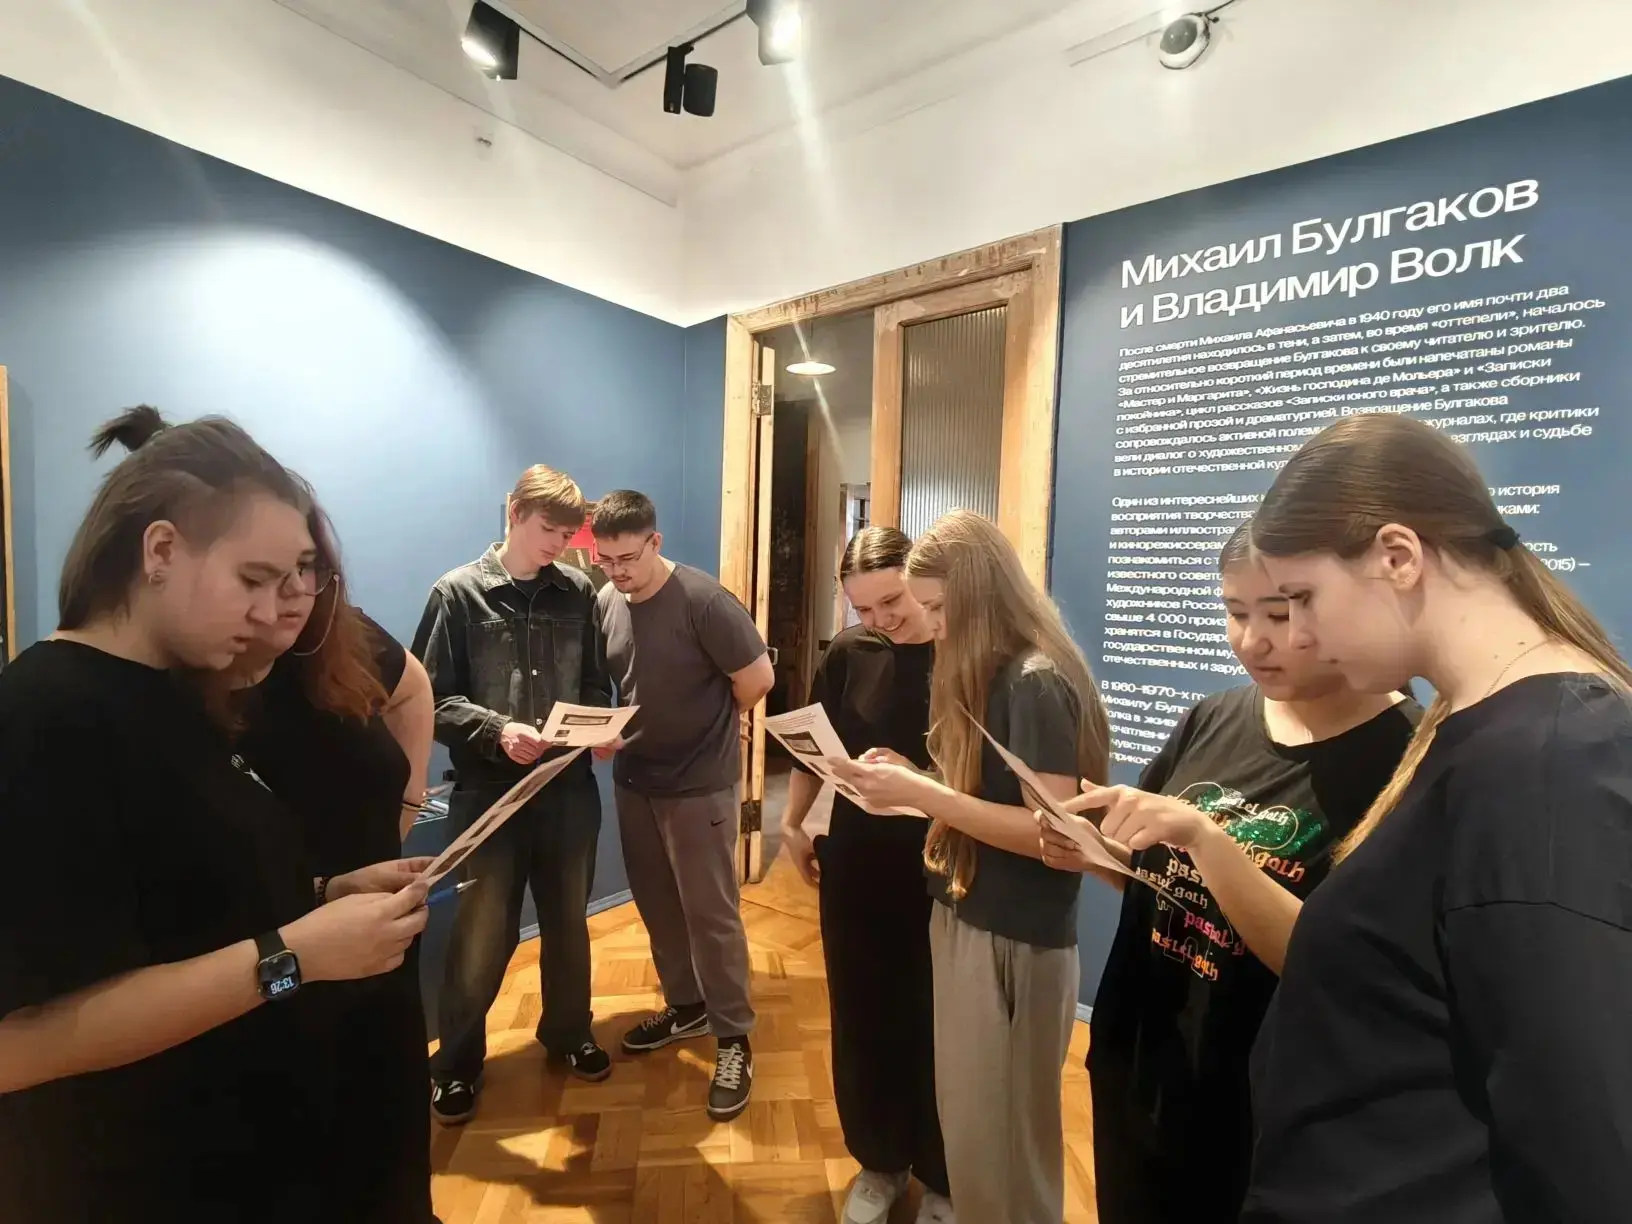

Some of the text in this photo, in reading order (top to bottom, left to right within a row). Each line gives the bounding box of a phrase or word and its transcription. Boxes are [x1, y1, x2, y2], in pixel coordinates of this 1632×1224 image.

[1121, 179, 1539, 289] Михаил Булгаков
[1120, 233, 1527, 329] и Владимир Волк
[1119, 285, 1569, 357] После смерти Михаила Афанасьевича в 1940 году его имя почти два
[1118, 298, 1605, 371] десятилетия находилось в тени, а затем, во время «оттепели», началось
[1118, 319, 1586, 384] стремительное возвращение Булгакова к своему читателю и зрителю.
[1118, 338, 1573, 397] За относительно короткий период времени были напечатаны романы
[1118, 358, 1552, 409] «Мастер и Маргарита», «Жизнь господина де Мольера» и «Записки
[1116, 409, 1184, 422] покойника»,
[1185, 406, 1216, 417] цикл
[1217, 398, 1283, 415] рассказов
[1347, 389, 1387, 401] юного
[1389, 385, 1439, 399] врача»,
[1441, 384, 1450, 393] а
[1453, 378, 1498, 392] также
[1501, 372, 1581, 387] сборники
[1115, 427, 1124, 435] с
[1125, 420, 1188, 434] избранной
[1189, 416, 1234, 430] прозой
[1236, 417, 1244, 425] и
[1245, 407, 1339, 426] драматургией.
[1434, 395, 1508, 411] Булгакова
[1115, 435, 1217, 450] сопровождалось
[1218, 427, 1276, 442] активной
[1500, 412, 1526, 424] где
[1529, 406, 1600, 421] критики
[1115, 454, 1142, 463] вели
[1142, 450, 1186, 463] диалог
[1187, 449, 1196, 459] о
[1520, 428, 1529, 439] и
[1532, 424, 1593, 440] судьбе
[1113, 468, 1121, 477] в
[1122, 465, 1171, 476] истории
[1172, 458, 1265, 475] отечественной
[1112, 497, 1143, 508] Один
[1144, 496, 1159, 505] из
[1160, 493, 1259, 507] интереснейших
[1498, 484, 1560, 497] история
[1110, 511, 1182, 522] восприятия
[1110, 526, 1169, 536] авторами
[1109, 541, 1117, 549] и
[1108, 556, 1202, 566] познакомиться
[1203, 557, 1213, 565] с
[1106, 570, 1177, 580] известного
[1106, 583, 1212, 597] Международной
[1105, 598, 1181, 609] художников
[1104, 612, 1144, 623] свыше
[1145, 612, 1156, 622] 4
[1158, 613, 1187, 624] 000
[1104, 626, 1161, 638] хранятся
[1163, 630, 1172, 638] в
[1102, 640, 1215, 657] государственном
[1102, 654, 1199, 670] отечественных
[1200, 662, 1209, 670] и
[1101, 680, 1109, 690] В
[1100, 693, 1153, 711] Михаилу
[1133, 713, 1141, 722] в
[1166, 858, 1205, 888] pas
[1254, 851, 1306, 883] goth
[1173, 886, 1208, 909] goth
[1194, 955, 1219, 981] goth
